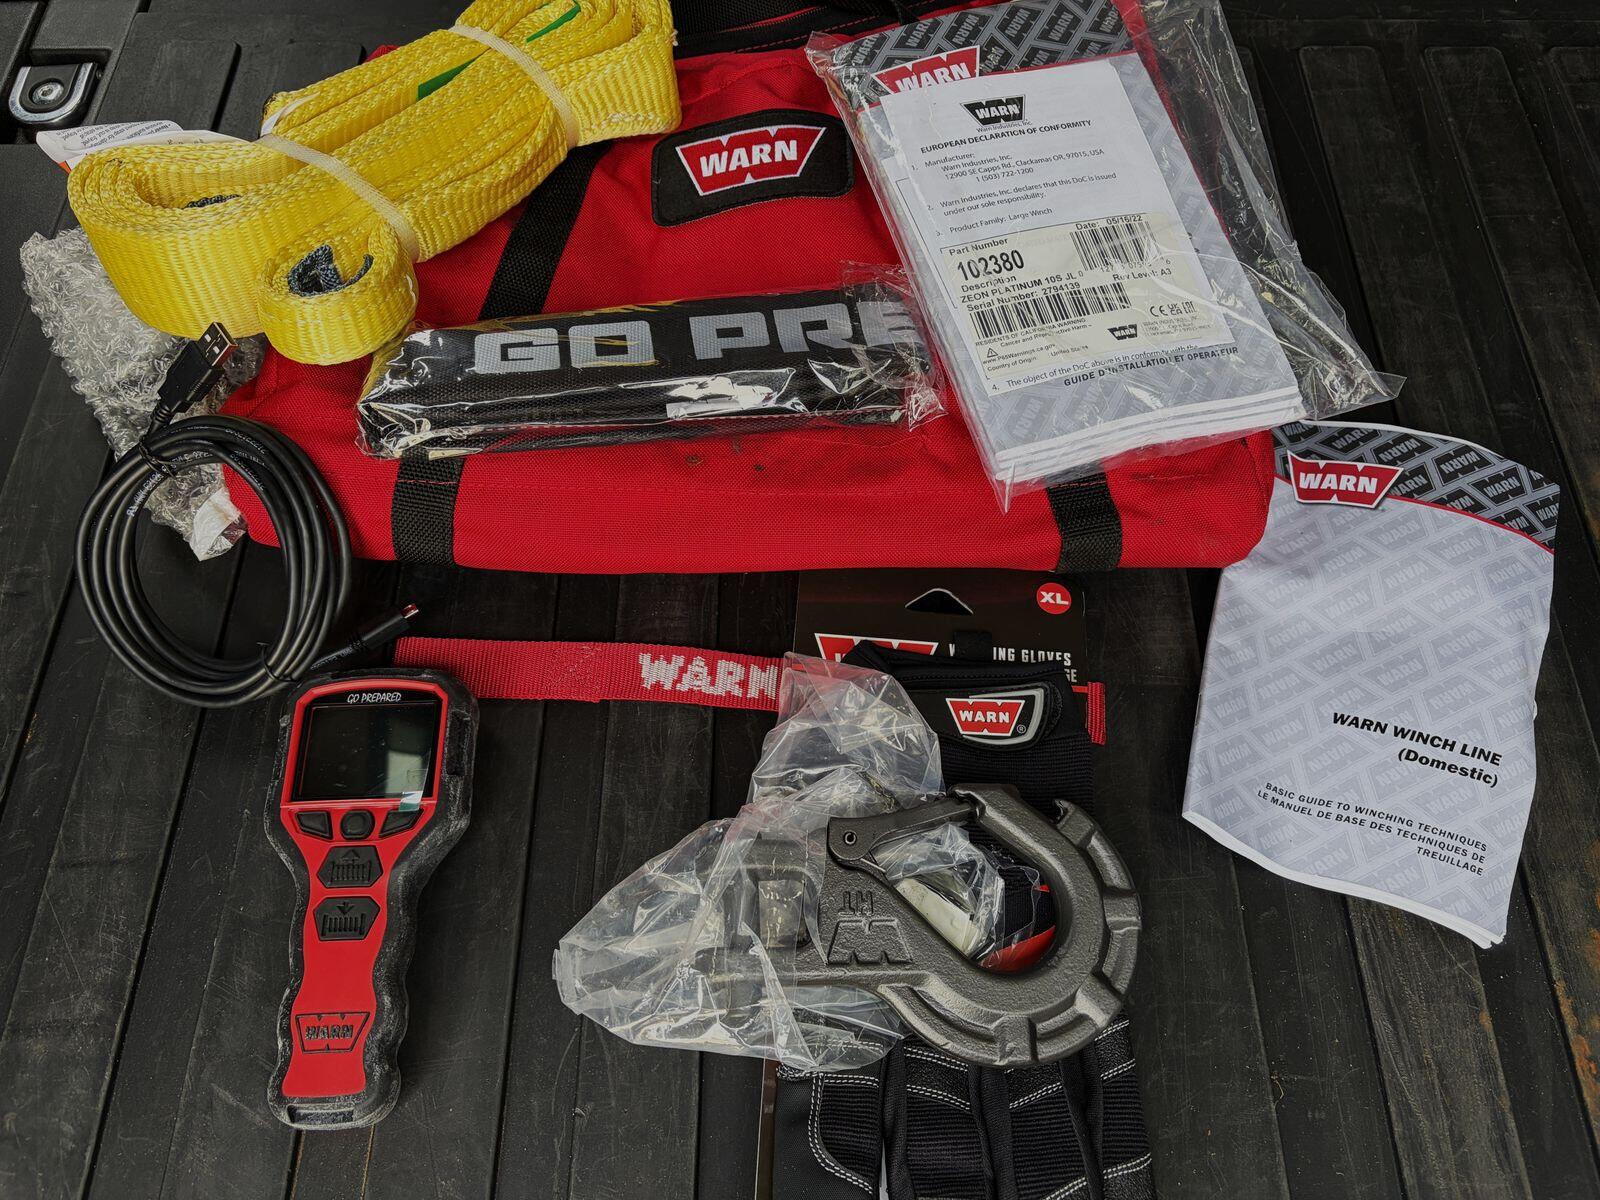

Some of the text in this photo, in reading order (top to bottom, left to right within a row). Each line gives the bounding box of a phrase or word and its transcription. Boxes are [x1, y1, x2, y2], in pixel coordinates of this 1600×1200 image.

[1005, 9, 1031, 38] WARN
[1048, 12, 1074, 42] WARN
[895, 61, 973, 92] WARN
[974, 103, 1021, 120] WARN
[920, 137, 967, 154] EUROPEAN
[968, 128, 1026, 144] DECLARATION
[1039, 120, 1091, 133] CONFORMITY
[698, 139, 798, 177] WARN
[925, 152, 975, 167] Manufacturer:
[945, 170, 967, 180] 12900
[978, 165, 1003, 177] Capps
[1015, 155, 1052, 168] Clackamas
[961, 157, 999, 171] Industries,
[982, 172, 1000, 183] (503)
[1000, 167, 1034, 178] 722-1200
[960, 192, 998, 206] Industries,
[1013, 184, 1042, 195] declares
[1043, 179, 1058, 188] that
[1058, 177, 1071, 185] this
[1072, 176, 1088, 184] DoC
[1094, 170, 1116, 182] issued
[944, 207, 966, 216] under
[967, 204, 979, 212] our
[997, 191, 1046, 206] responsibility.
[950, 222, 979, 233] Product
[980, 217, 1007, 226] Family:
[1008, 211, 1029, 222] Large
[1029, 208, 1052, 216] Winch
[1075, 213, 1142, 231] Date: 05/16/22
[949, 238, 1008, 256] Part Number
[957, 249, 1024, 282] 102380
[1161, 268, 1172, 276] A3
[960, 291, 989, 303] ZEON
[991, 279, 1044, 296] PLATINUM
[1045, 274, 1062, 284] 10S
[967, 299, 997, 311] Serial
[1041, 282, 1080, 295] 2794139
[477, 320, 655, 374] GO
[975, 335, 1010, 346] RESIDENTS
[987, 361, 1014, 372] Country
[1006, 379, 1021, 387] The
[1023, 372, 1047, 383] object
[1049, 369, 1056, 377] of
[1072, 362, 1090, 371] DoC
[1063, 371, 1095, 386] GUIDE
[1174, 354, 1184, 362] ET
[1379, 437, 1420, 464] WARN
[1440, 450, 1480, 475] WARN
[1299, 472, 1379, 495] WARN
[1484, 475, 1519, 498] WARN
[1040, 590, 1070, 605] XL
[639, 652, 776, 699] WARN
[346, 691, 401, 703] GO PREPARED
[960, 709, 1010, 724] WARN
[1333, 712, 1503, 766] WARN WINCH LINE
[1398, 748, 1500, 788] (Domestic)
[1258, 790, 1485, 864] LE MANUEL DE BASE DES TECHNIQUES DE
[1264, 783, 1488, 852] BASIC GUIDE TO WINCHING TECHNIQUES
[1415, 846, 1484, 876] TREUILLAGE
